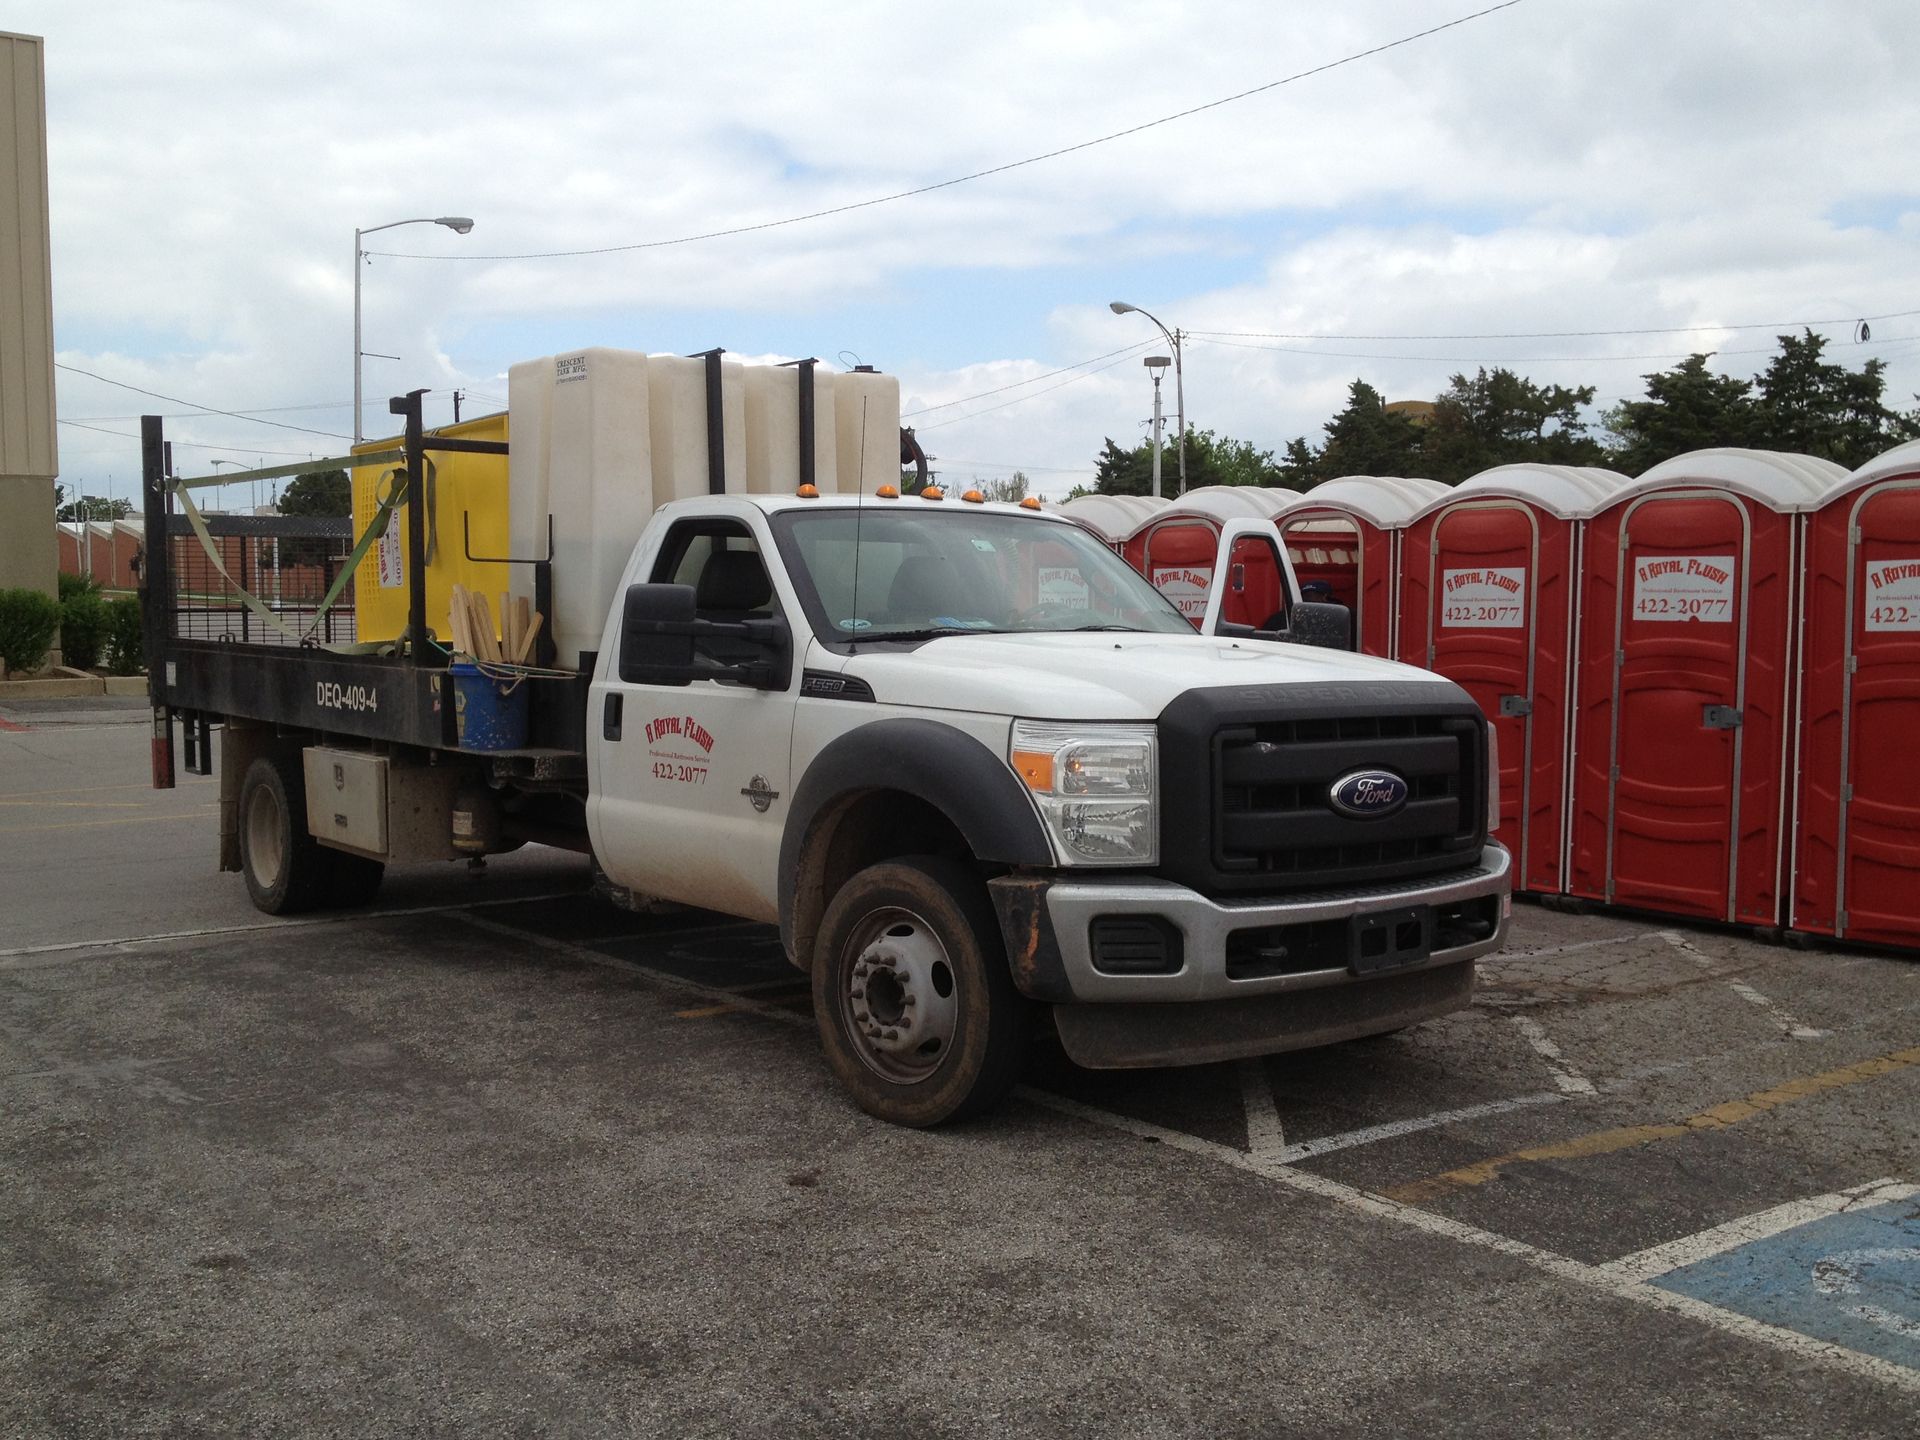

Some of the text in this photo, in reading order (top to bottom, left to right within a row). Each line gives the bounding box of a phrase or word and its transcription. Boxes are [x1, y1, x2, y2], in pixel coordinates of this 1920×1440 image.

[1160, 571, 1181, 586] ROYAL
[1182, 569, 1209, 590] FLUSH
[1446, 570, 1521, 594] A ROYAL FLUSH
[1637, 558, 1729, 585] A ROYAL FLUSH
[1871, 572, 1883, 589] A
[1178, 600, 1209, 613] 2077
[1445, 606, 1520, 621] 422-2077
[1637, 598, 1728, 615] 422-2077
[1869, 606, 1920, 624] 422-
[316, 681, 378, 713] DEQ-409-4
[645, 716, 714, 754] A ROYAL FLUSH
[652, 761, 708, 785] 422-2077
[1353, 778, 1395, 805] Ford
